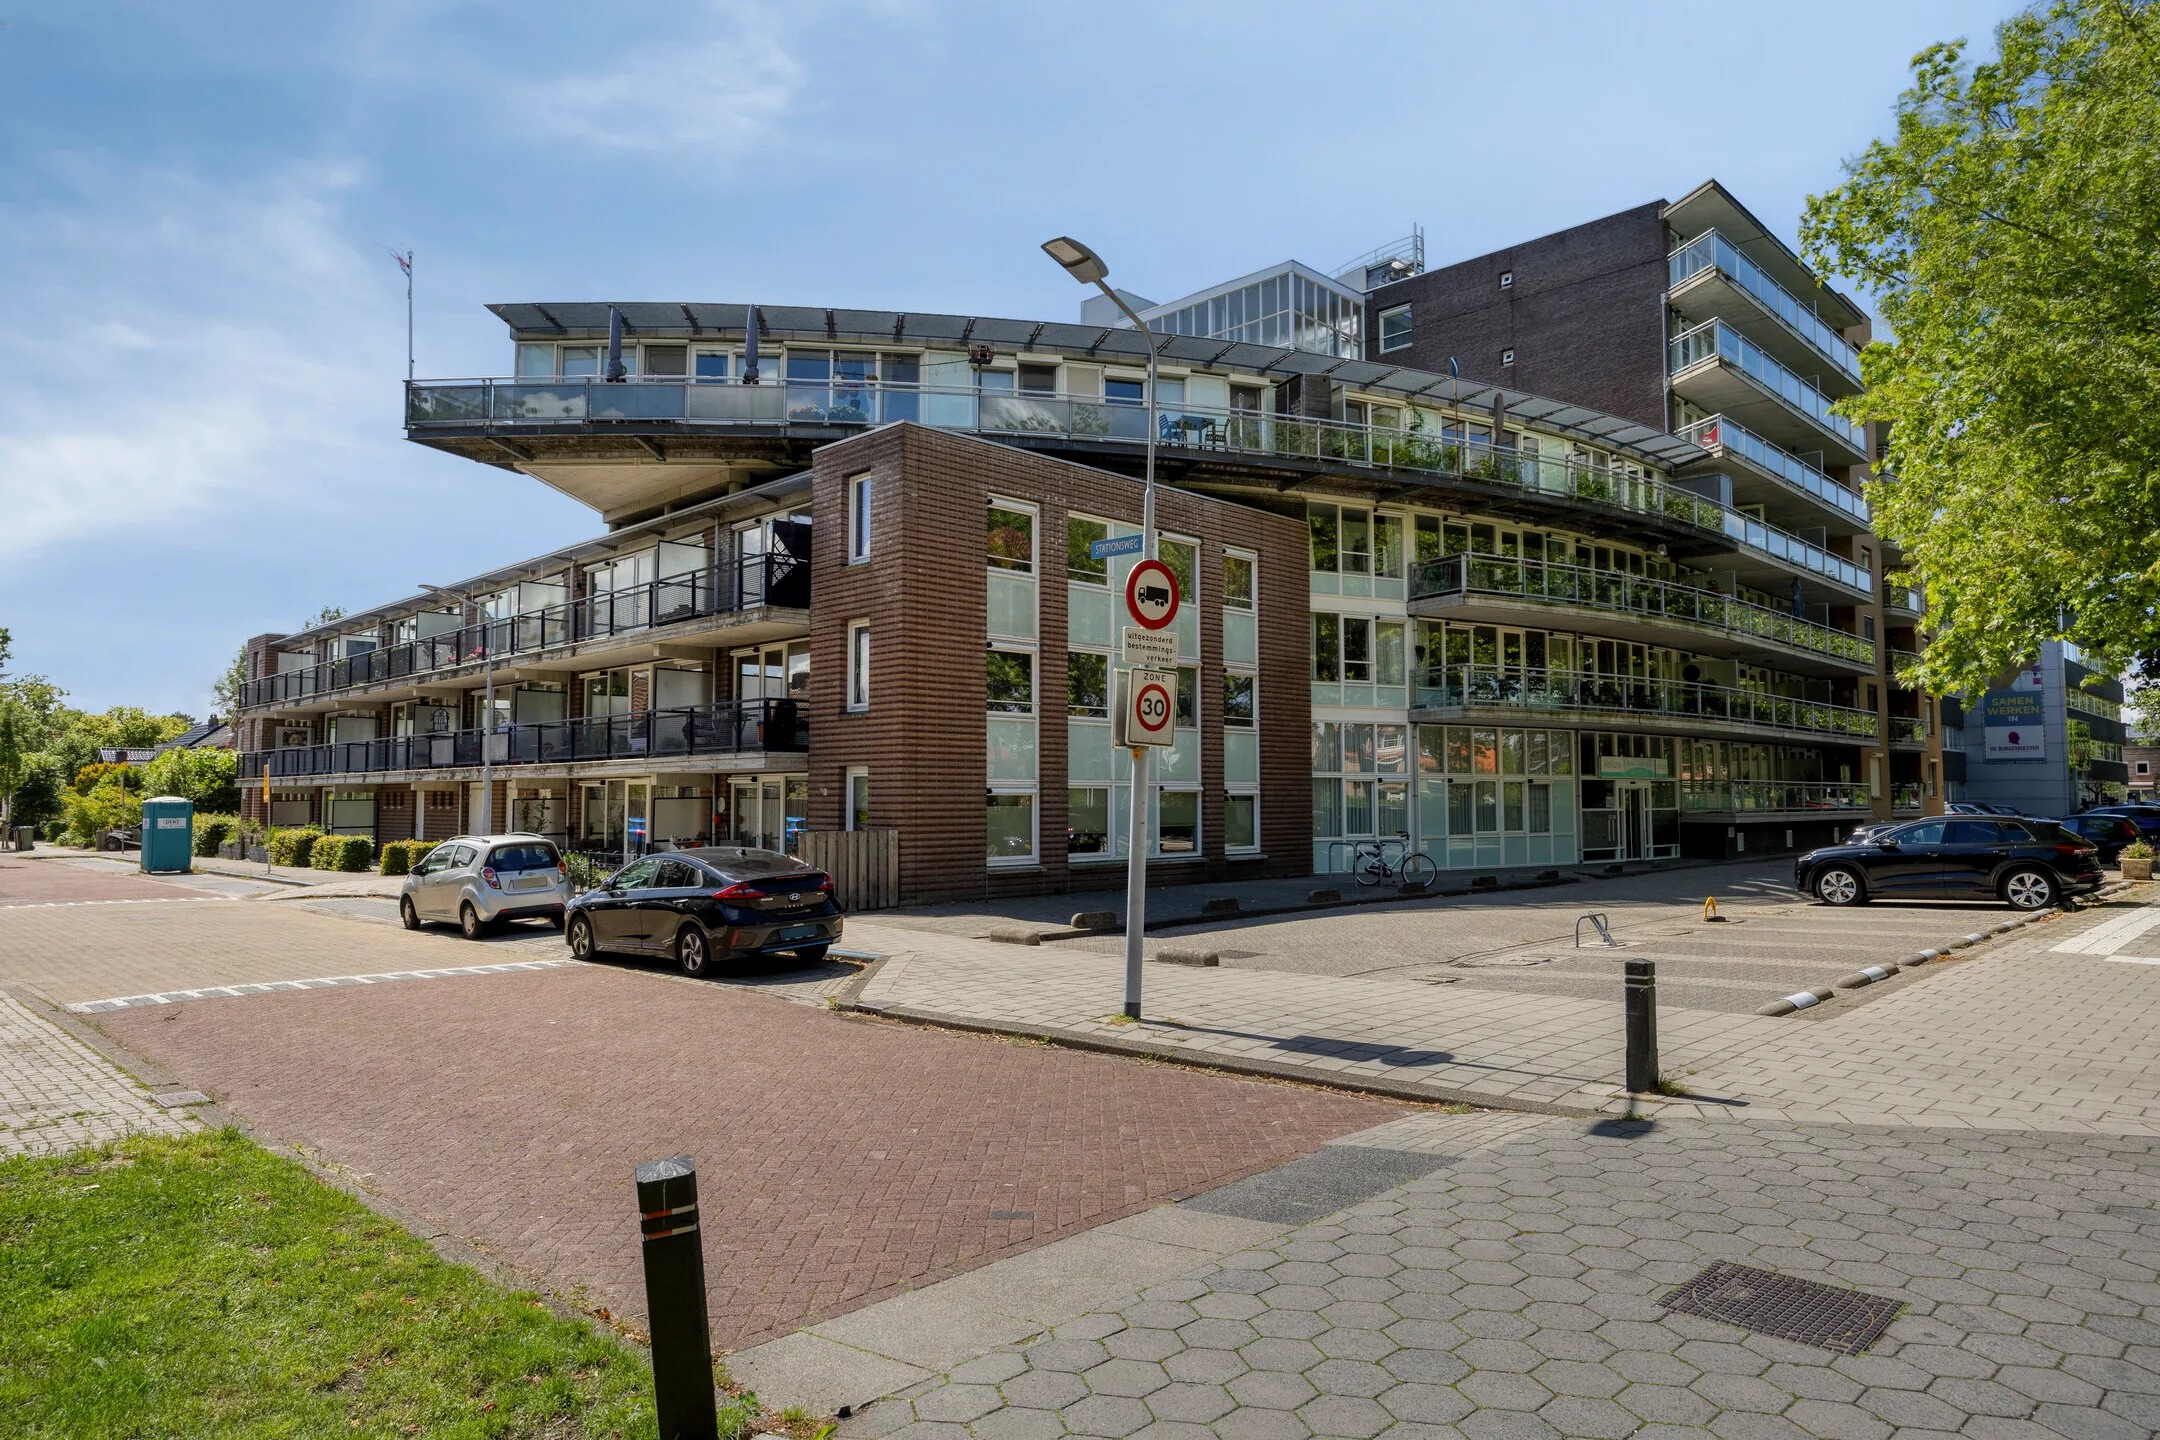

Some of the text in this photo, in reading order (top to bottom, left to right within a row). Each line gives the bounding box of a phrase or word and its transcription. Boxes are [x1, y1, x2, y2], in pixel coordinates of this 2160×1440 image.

[1095, 539, 1138, 554] STATIONSWEG
[1128, 632, 1173, 645] uitgezonderd
[1128, 642, 1176, 655] bestemmings-
[1146, 655, 1172, 663] verkeer
[1144, 673, 1166, 682] ZONE
[1142, 697, 1165, 717] 30
[1991, 697, 2033, 706] SAMEN
[1987, 706, 2040, 715] WERKEN
